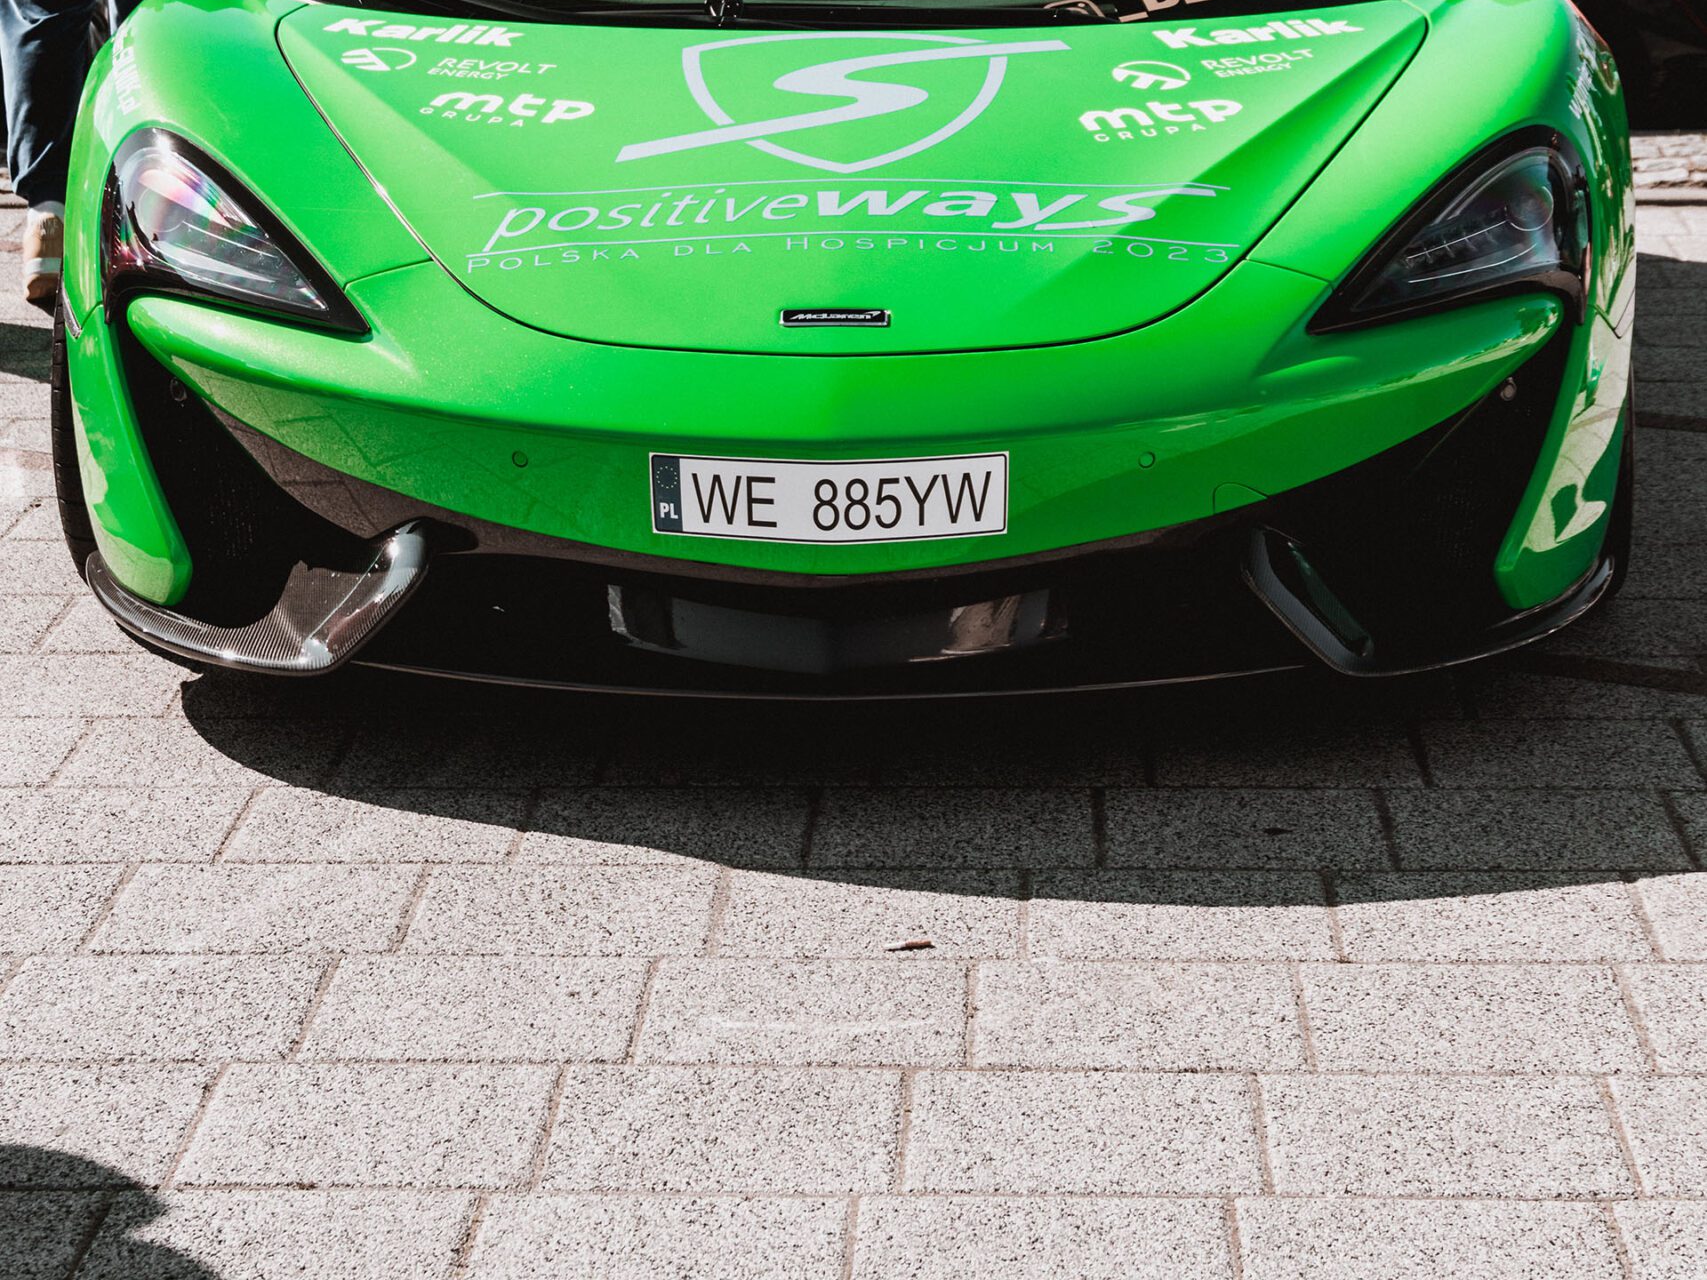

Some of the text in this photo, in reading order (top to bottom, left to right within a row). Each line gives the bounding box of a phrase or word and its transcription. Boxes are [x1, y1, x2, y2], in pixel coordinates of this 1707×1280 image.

[323, 18, 526, 47] Karlik
[1151, 18, 1365, 49] Karlik
[437, 57, 557, 75] REVOLT
[1201, 48, 1315, 71] REVOLT
[1213, 62, 1295, 79] ENERGY
[427, 68, 510, 81] ENERGY
[419, 107, 525, 127] GRUPA
[429, 91, 595, 124] mtp
[1079, 99, 1243, 131] mtp
[1094, 123, 1207, 143] GRUPA
[467, 236, 1230, 274] POLSKA DLA HOSPICJUM 2023
[659, 502, 679, 519] PL
[691, 470, 992, 532] WE 885YW
